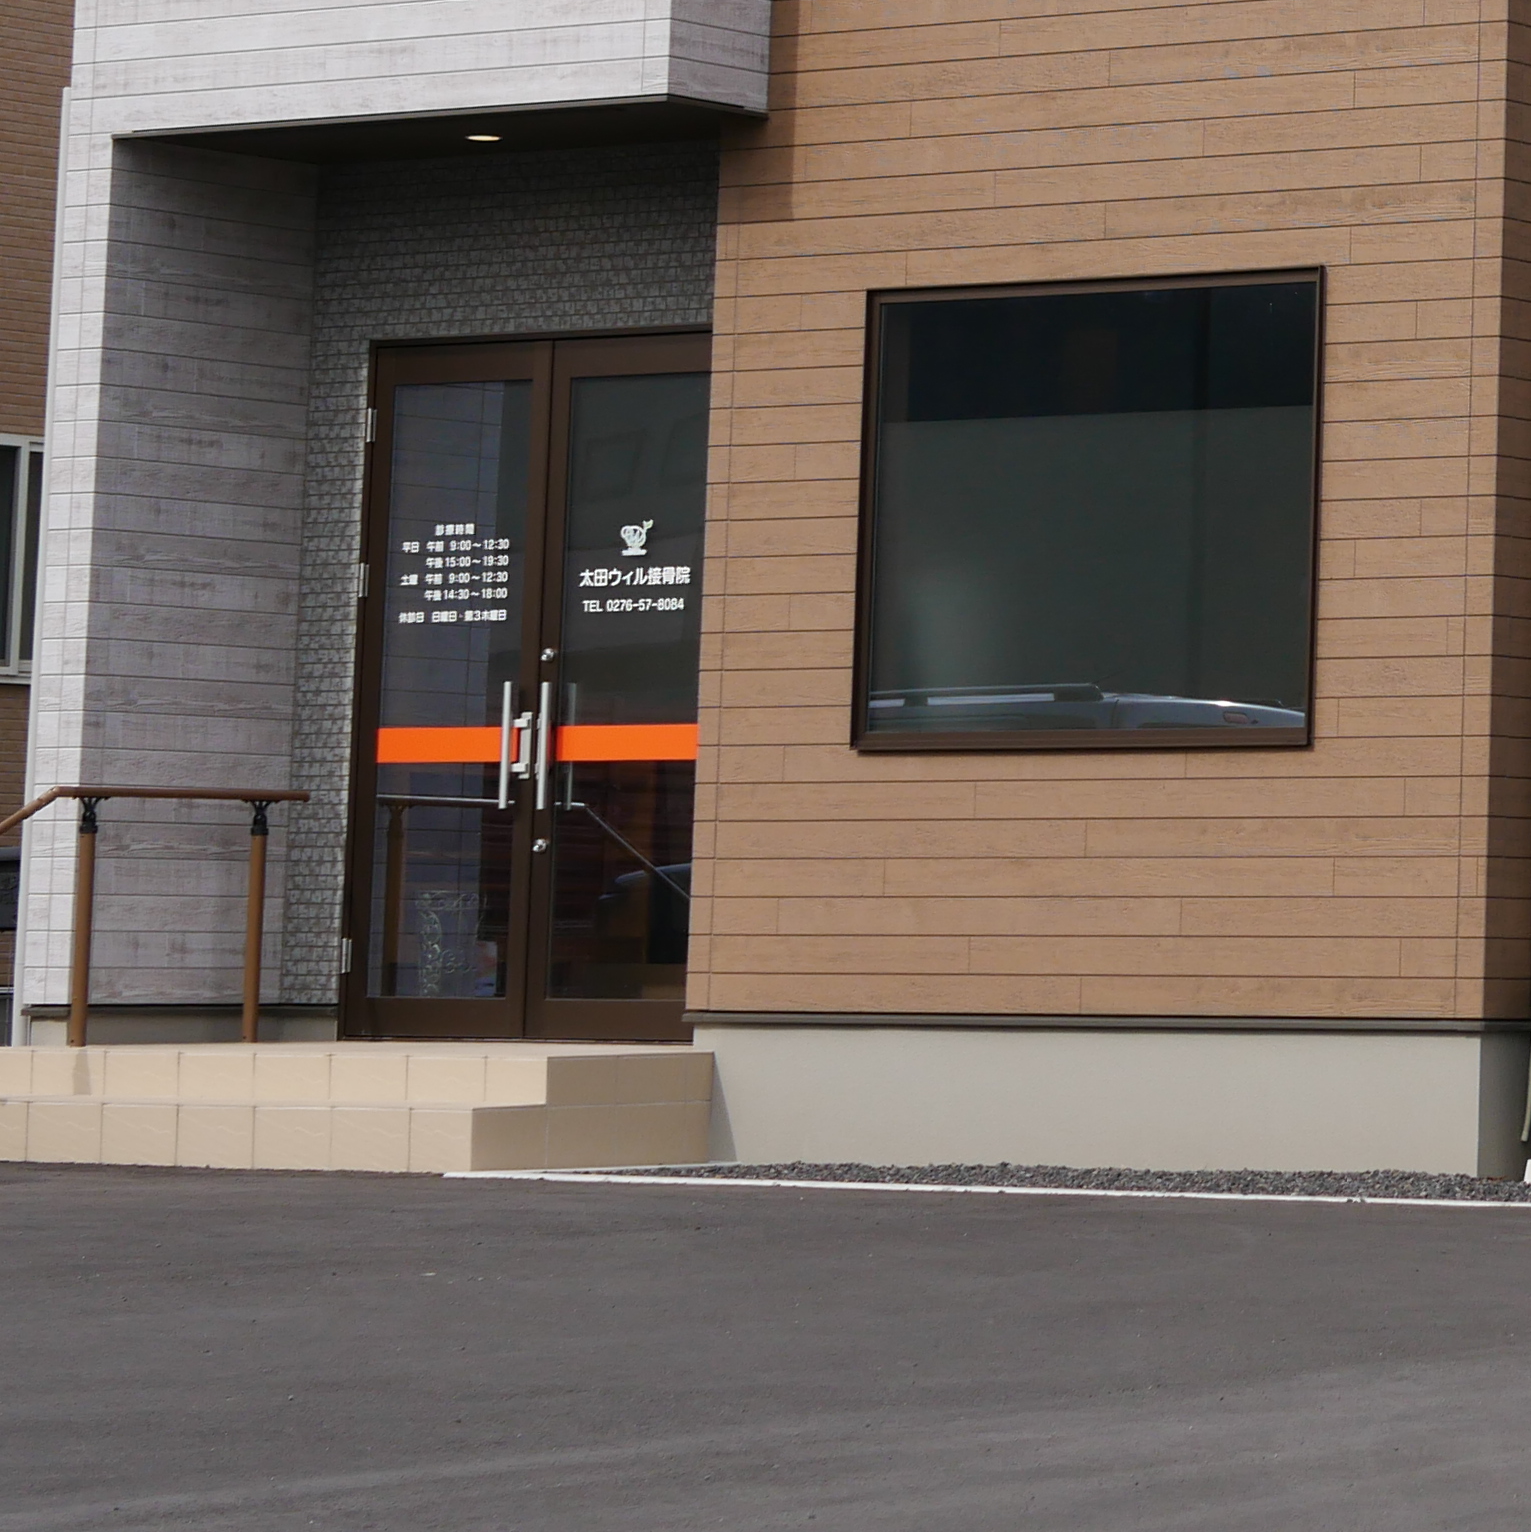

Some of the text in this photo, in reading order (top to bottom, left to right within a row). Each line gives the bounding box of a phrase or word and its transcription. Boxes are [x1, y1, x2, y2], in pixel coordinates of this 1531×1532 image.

[579, 566, 691, 587] 太田ウィル接骨院
[582, 597, 685, 612] TEL 0276-57-8084
